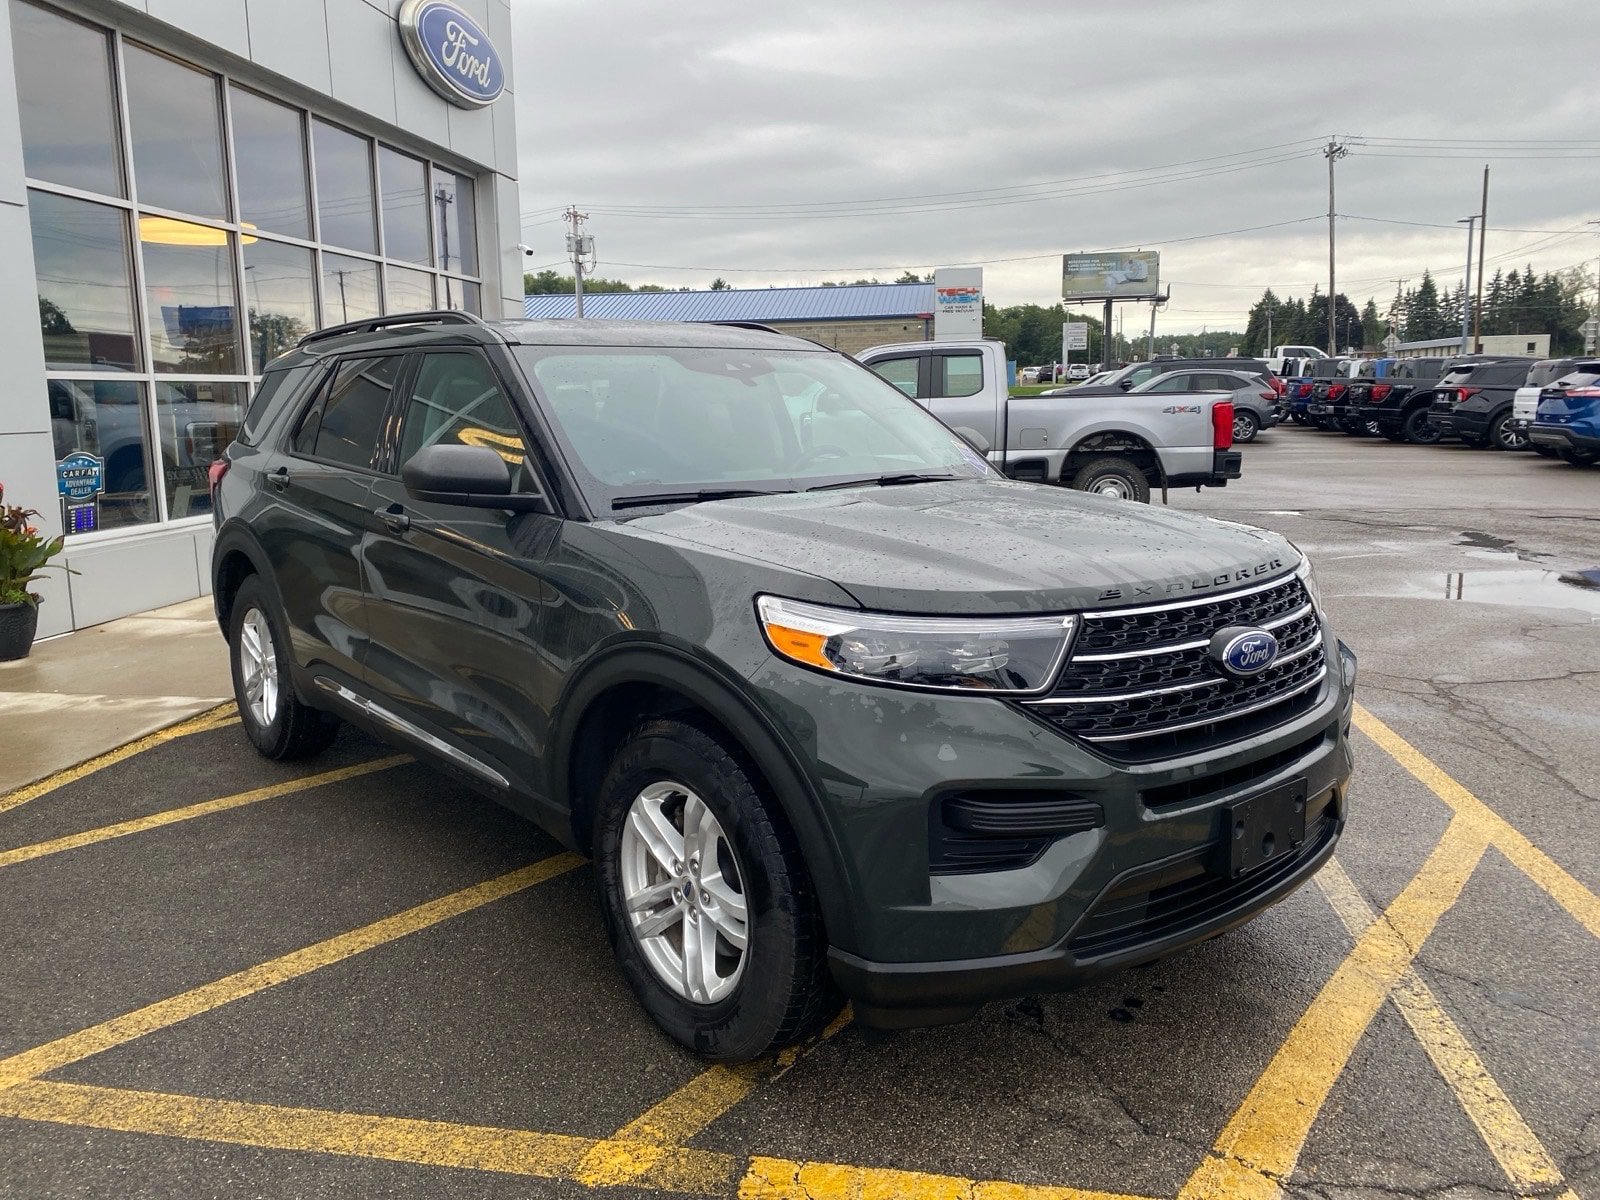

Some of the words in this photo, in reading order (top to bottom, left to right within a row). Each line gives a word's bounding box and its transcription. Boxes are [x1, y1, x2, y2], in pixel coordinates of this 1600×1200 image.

[442, 21, 490, 88] Ford
[938, 295, 979, 304] WASH
[62, 468, 99, 478] CARFAX
[65, 478, 97, 488] ADVANTAGE
[70, 487, 92, 496] DEALER
[1098, 559, 1283, 601] EXPLORER
[1240, 639, 1269, 667] Ford
